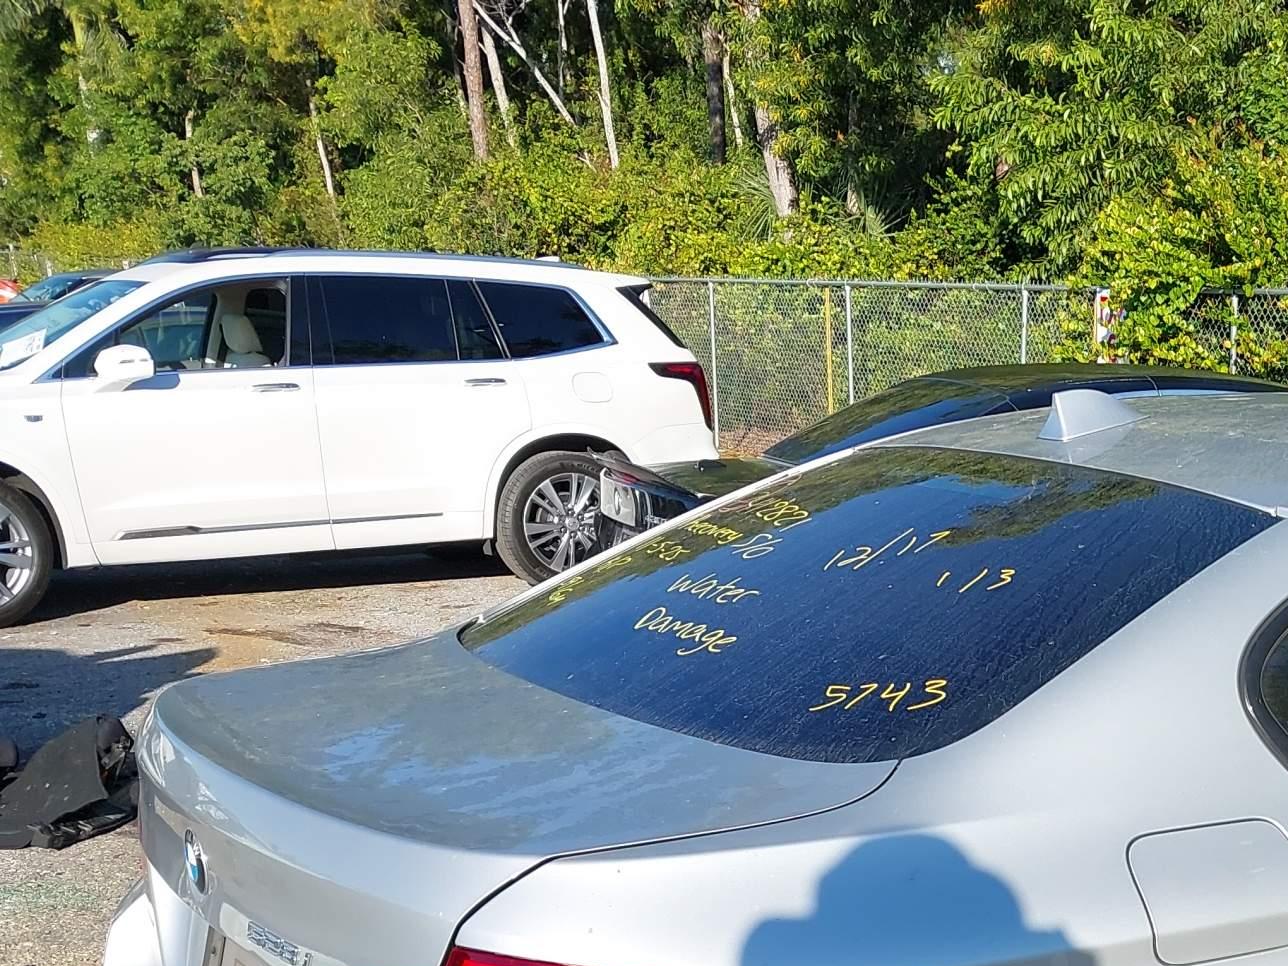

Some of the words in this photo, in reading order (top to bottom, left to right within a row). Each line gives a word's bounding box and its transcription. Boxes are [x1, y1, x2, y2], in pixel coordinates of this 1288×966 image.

[823, 527, 951, 571] 12/17
[667, 573, 761, 603] Water
[634, 606, 737, 656] Damage
[808, 679, 947, 712] 5743
